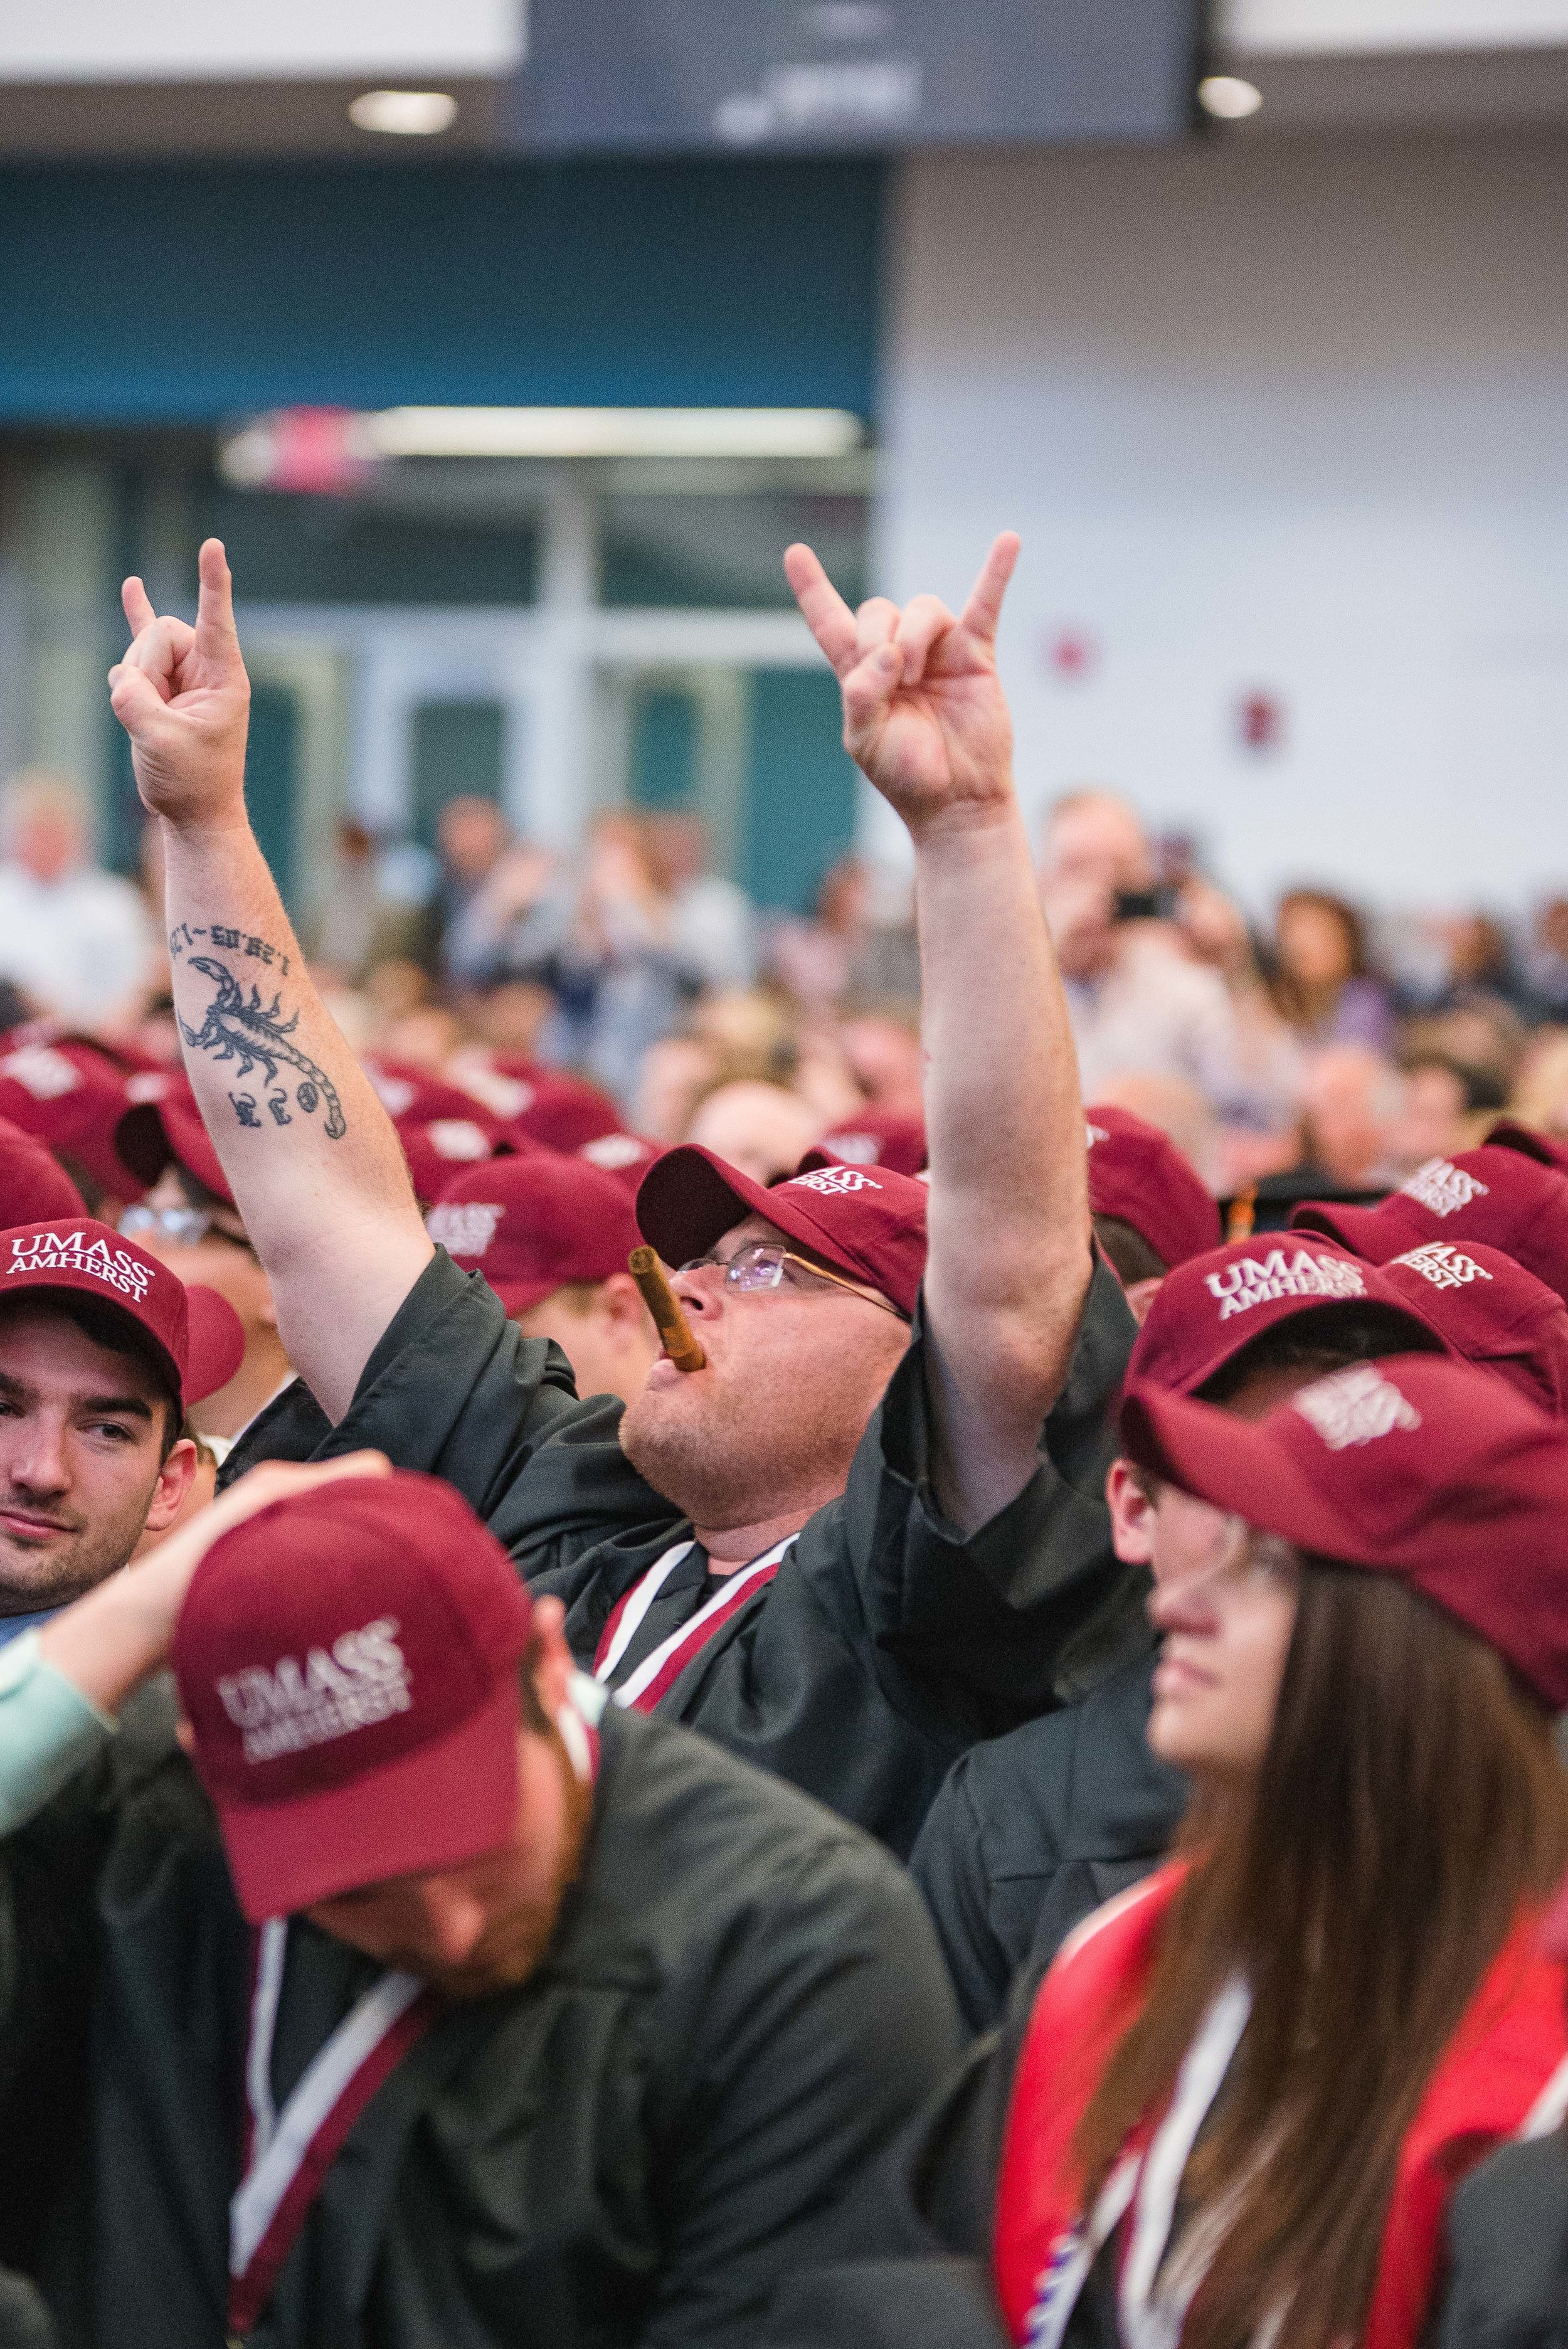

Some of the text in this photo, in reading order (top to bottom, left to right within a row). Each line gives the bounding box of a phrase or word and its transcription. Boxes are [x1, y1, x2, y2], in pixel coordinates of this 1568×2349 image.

[806, 1165, 882, 1190] ASS
[6, 1252, 147, 1303] AMHERST
[11, 1231, 154, 1286] UMASS
[1204, 1249, 1364, 1298] UMASS
